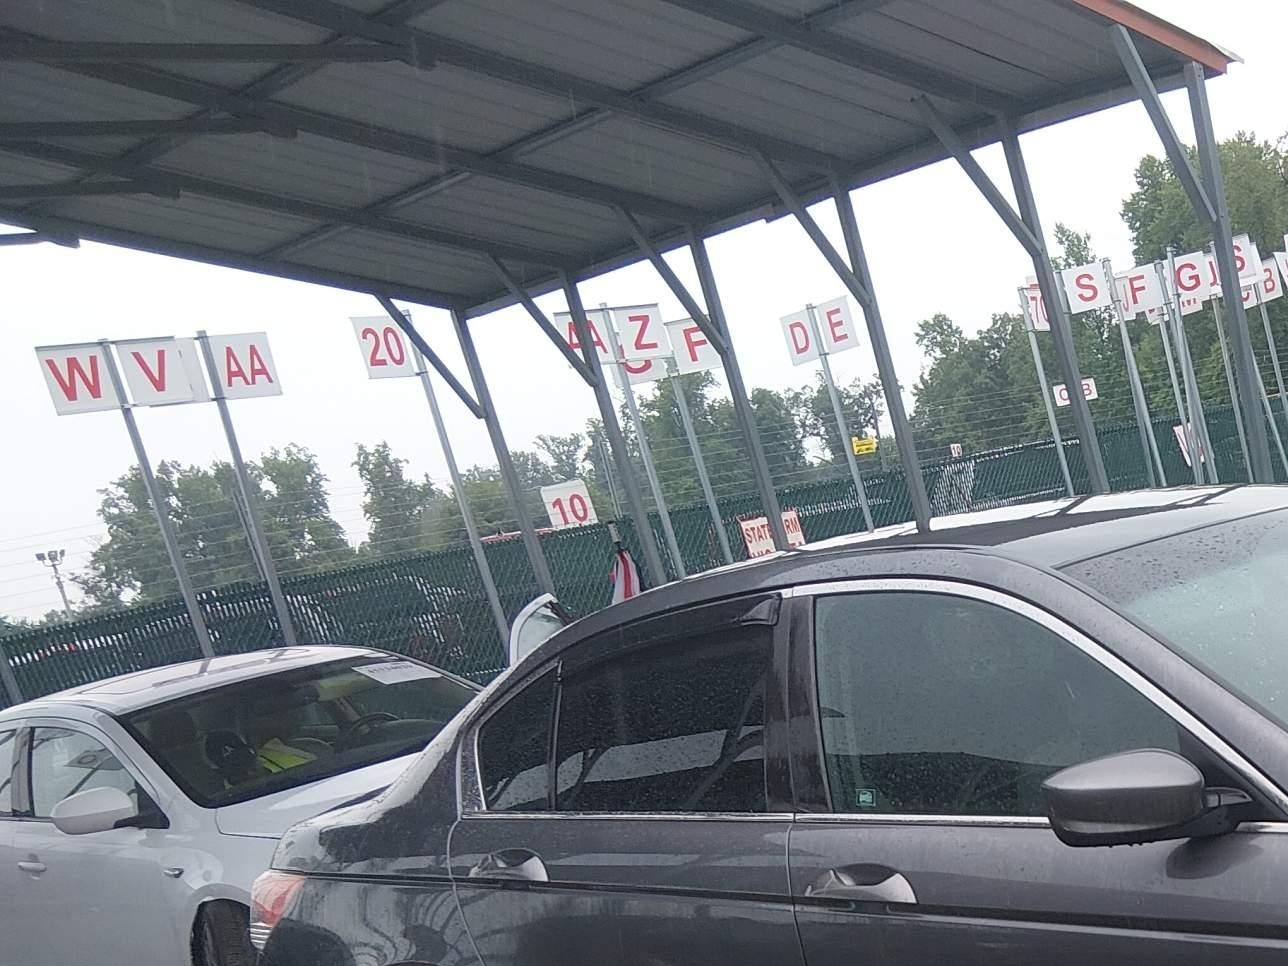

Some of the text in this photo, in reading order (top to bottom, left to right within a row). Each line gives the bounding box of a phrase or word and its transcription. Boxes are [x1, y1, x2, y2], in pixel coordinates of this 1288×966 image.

[1075, 273, 1099, 302] S
[1129, 275, 1146, 304] F
[1176, 263, 1201, 292] G
[628, 315, 658, 350] Z
[789, 321, 810, 354] D
[826, 308, 849, 343] E
[361, 326, 405, 366] 20
[682, 325, 708, 362] F
[45, 355, 102, 401] W
[131, 349, 166, 392] V
[225, 344, 274, 387] AA
[551, 494, 588, 526] 10
